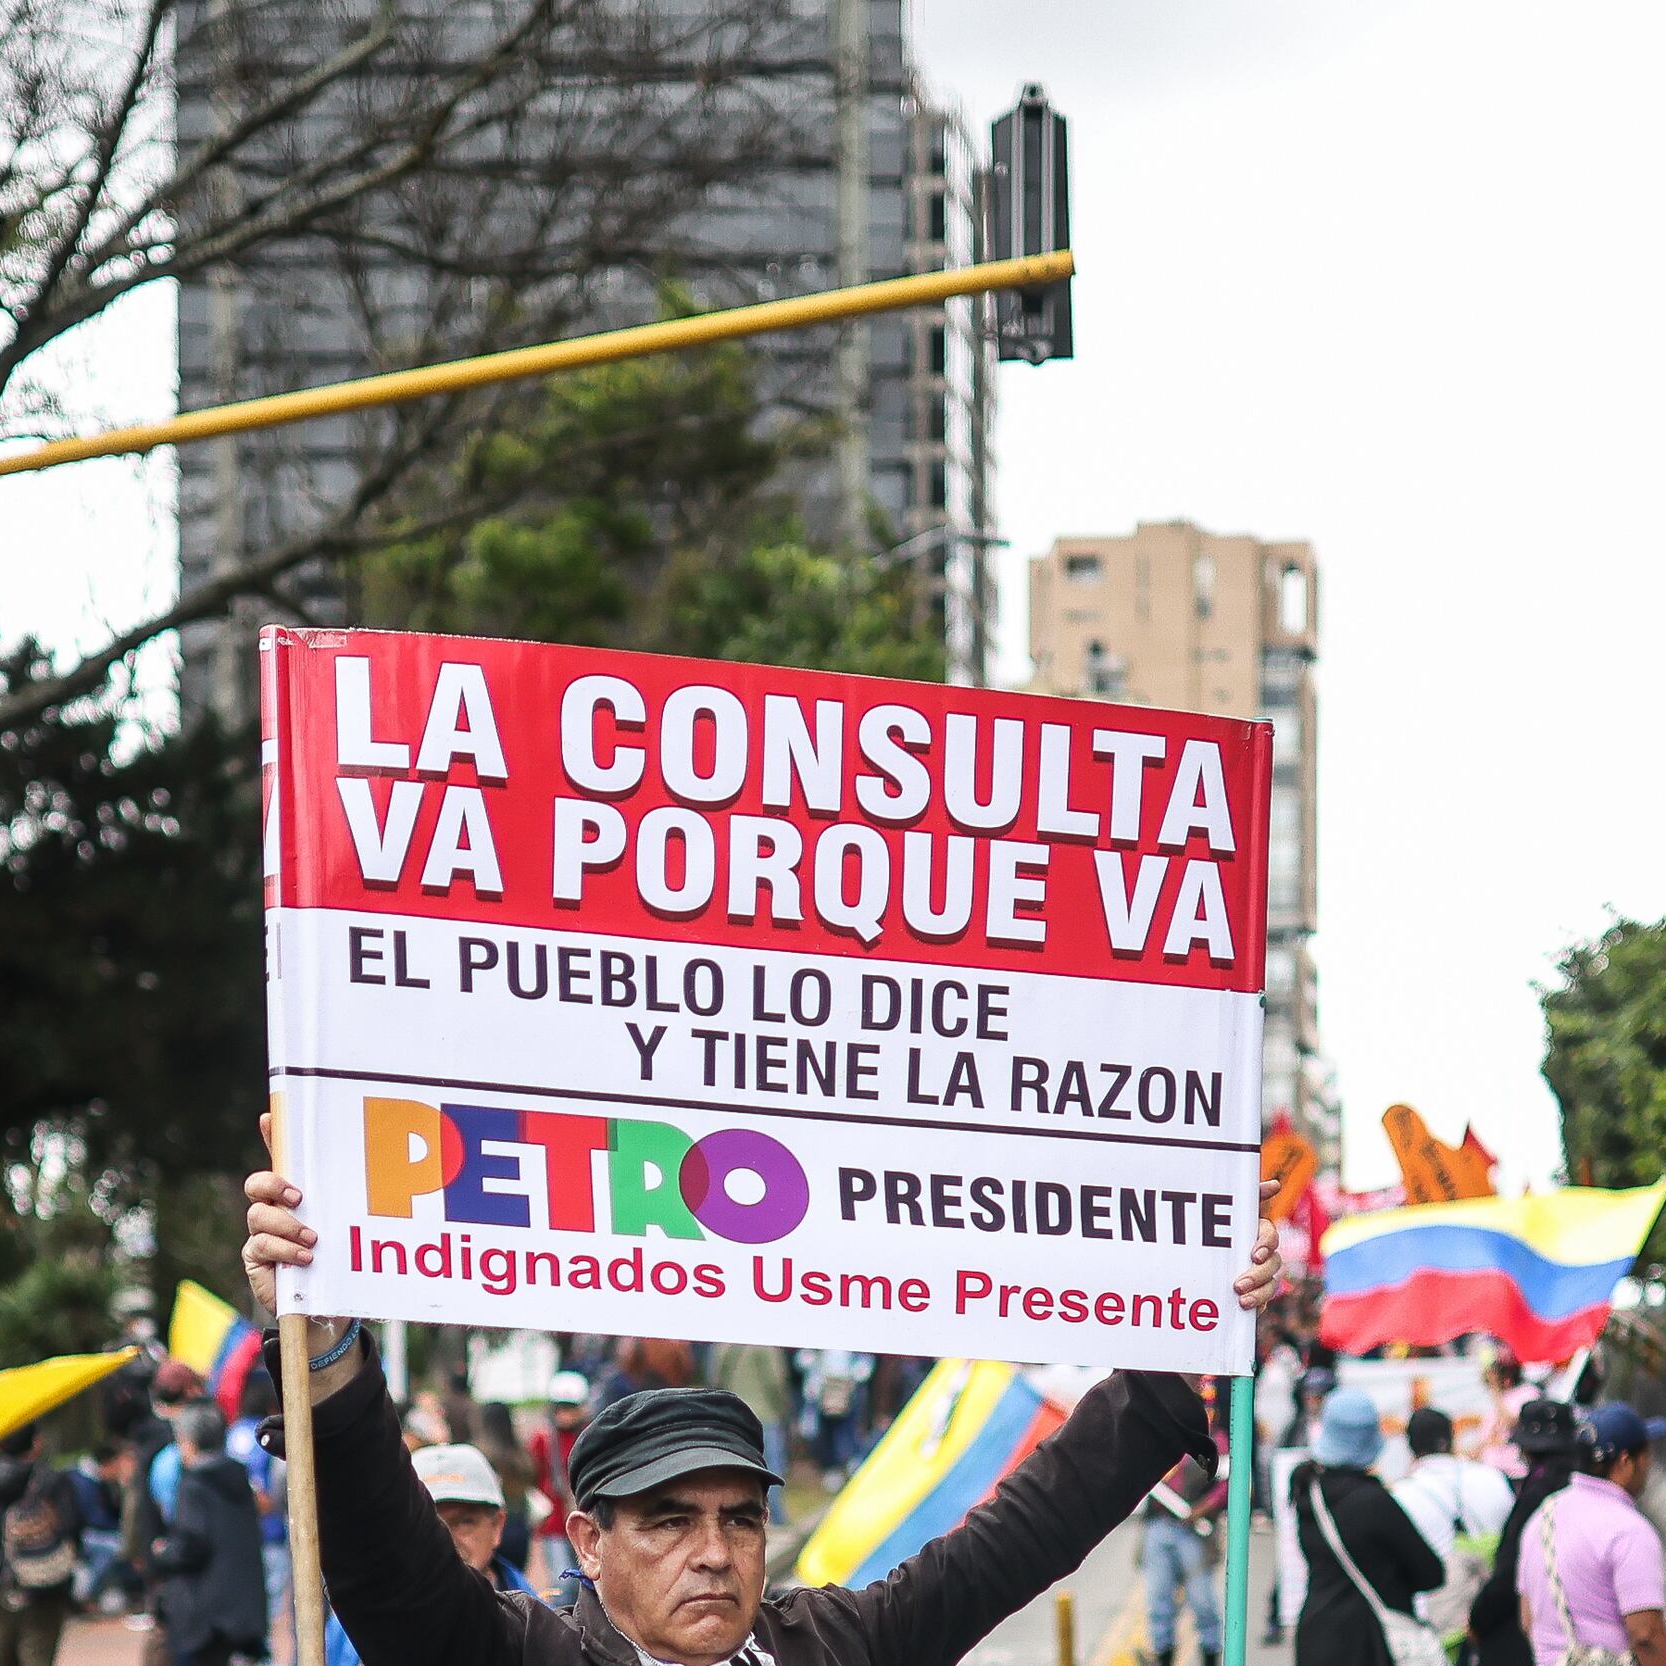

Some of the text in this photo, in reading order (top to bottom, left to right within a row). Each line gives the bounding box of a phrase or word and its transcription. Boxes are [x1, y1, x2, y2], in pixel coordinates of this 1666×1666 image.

[334, 655, 1237, 856] LA CONSULTA
[335, 776, 1235, 967] VA PORQUE VA
[348, 926, 1010, 1042] EL PUEBLO LO DICE
[624, 1022, 1223, 1127] Y TIENE LA RAZON
[363, 1096, 1234, 1249] PETRO PRESIDENTE
[350, 1225, 1220, 1332] Indignados Usme Presente
[310, 1337, 353, 1370] DEFIENDO
